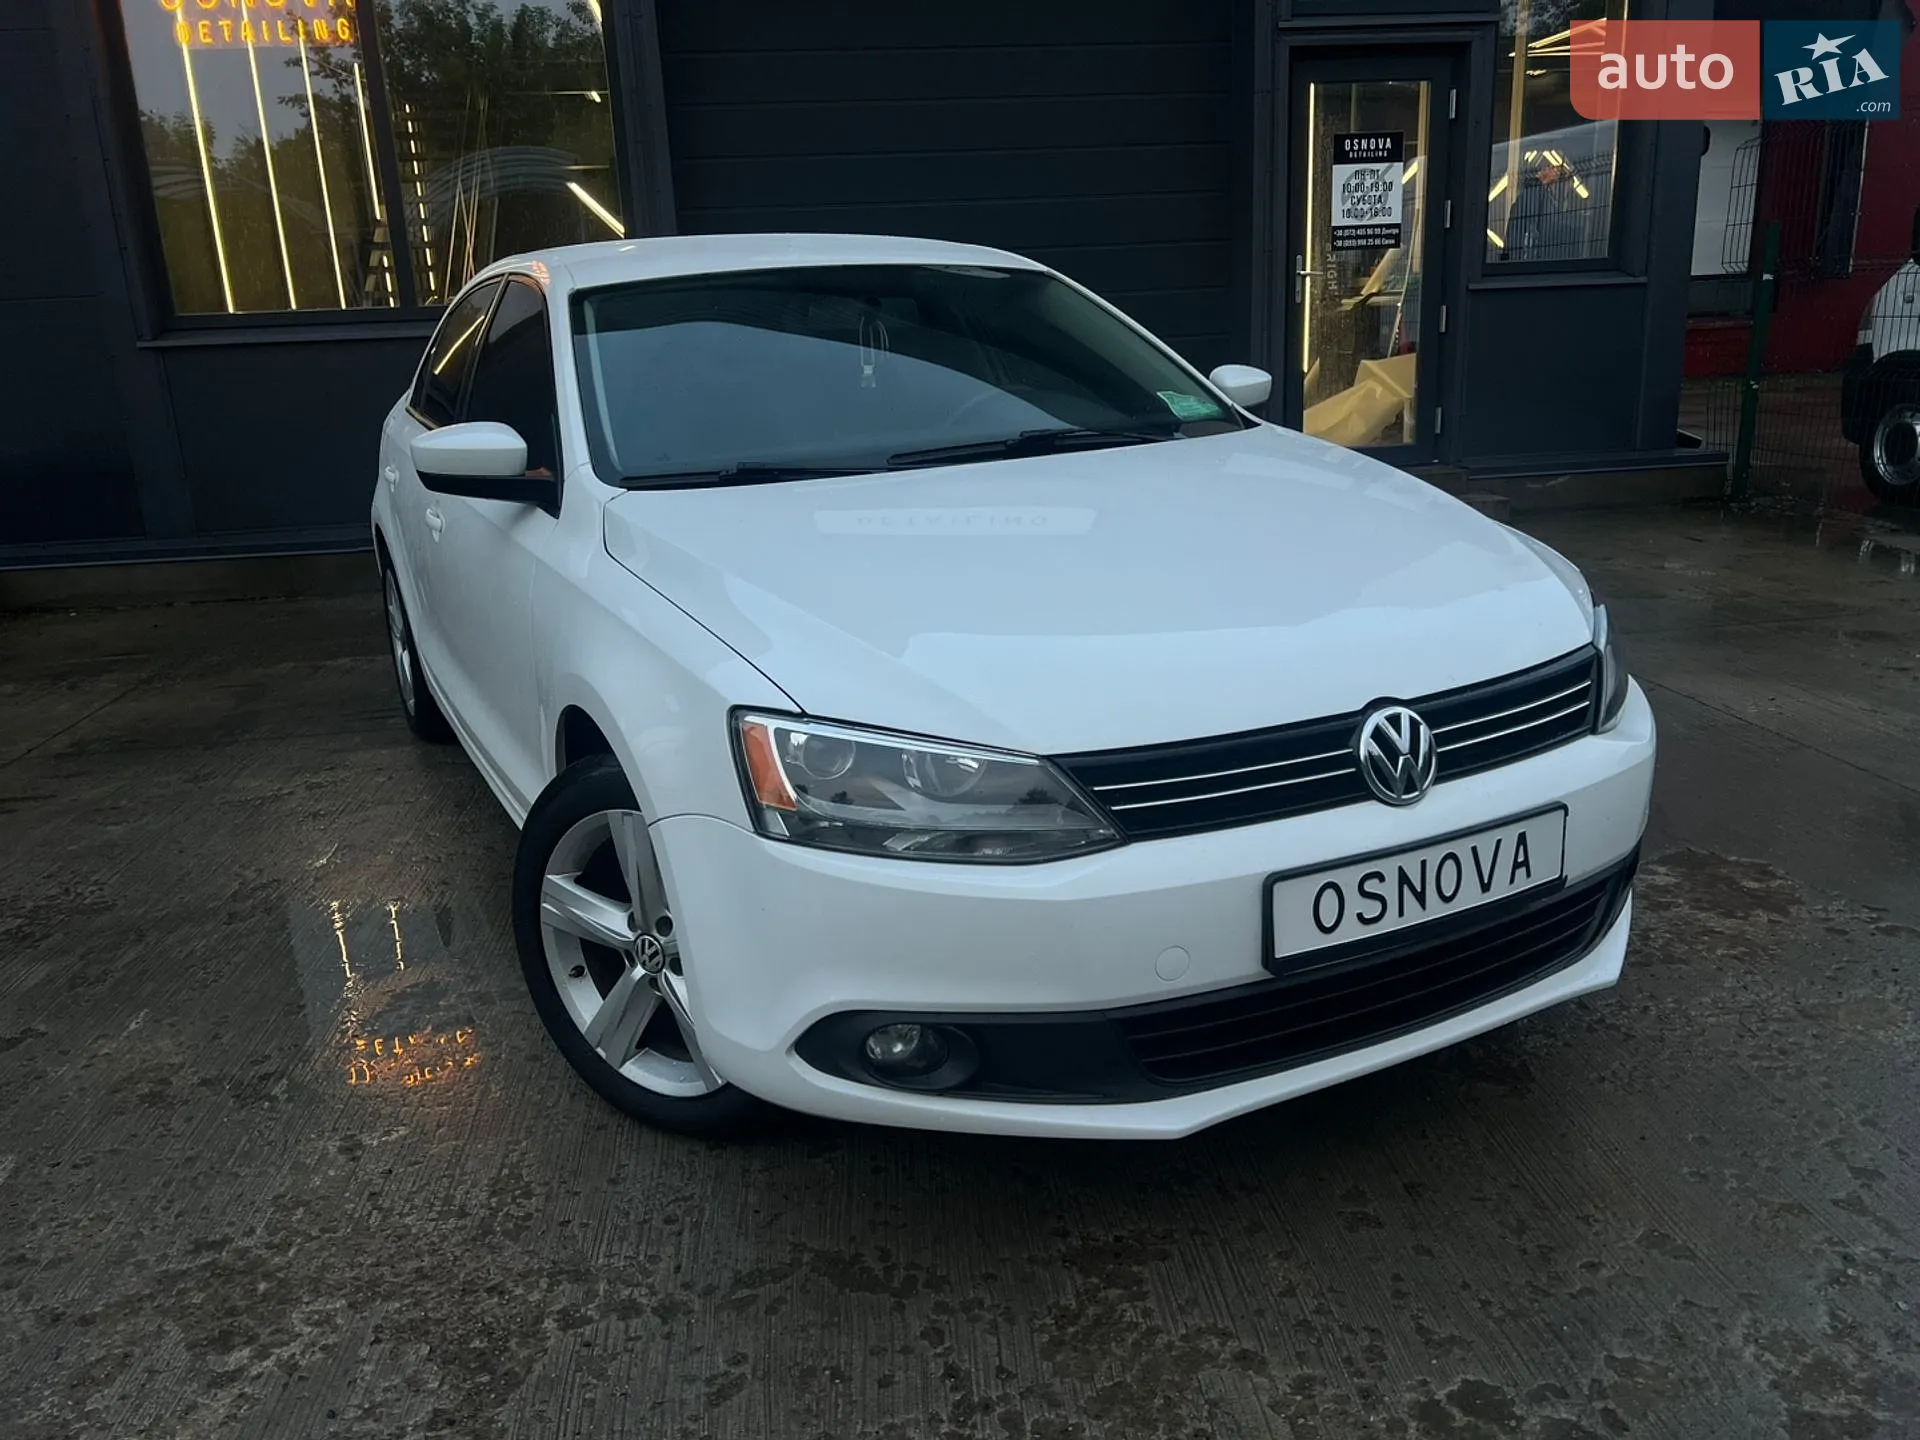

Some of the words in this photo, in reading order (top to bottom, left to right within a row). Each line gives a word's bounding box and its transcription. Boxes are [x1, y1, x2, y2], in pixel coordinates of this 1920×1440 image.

[176, 18, 351, 43] DETAILING
[1344, 137, 1392, 151] OSNOVA
[1313, 831, 1532, 934] OSNOVA
